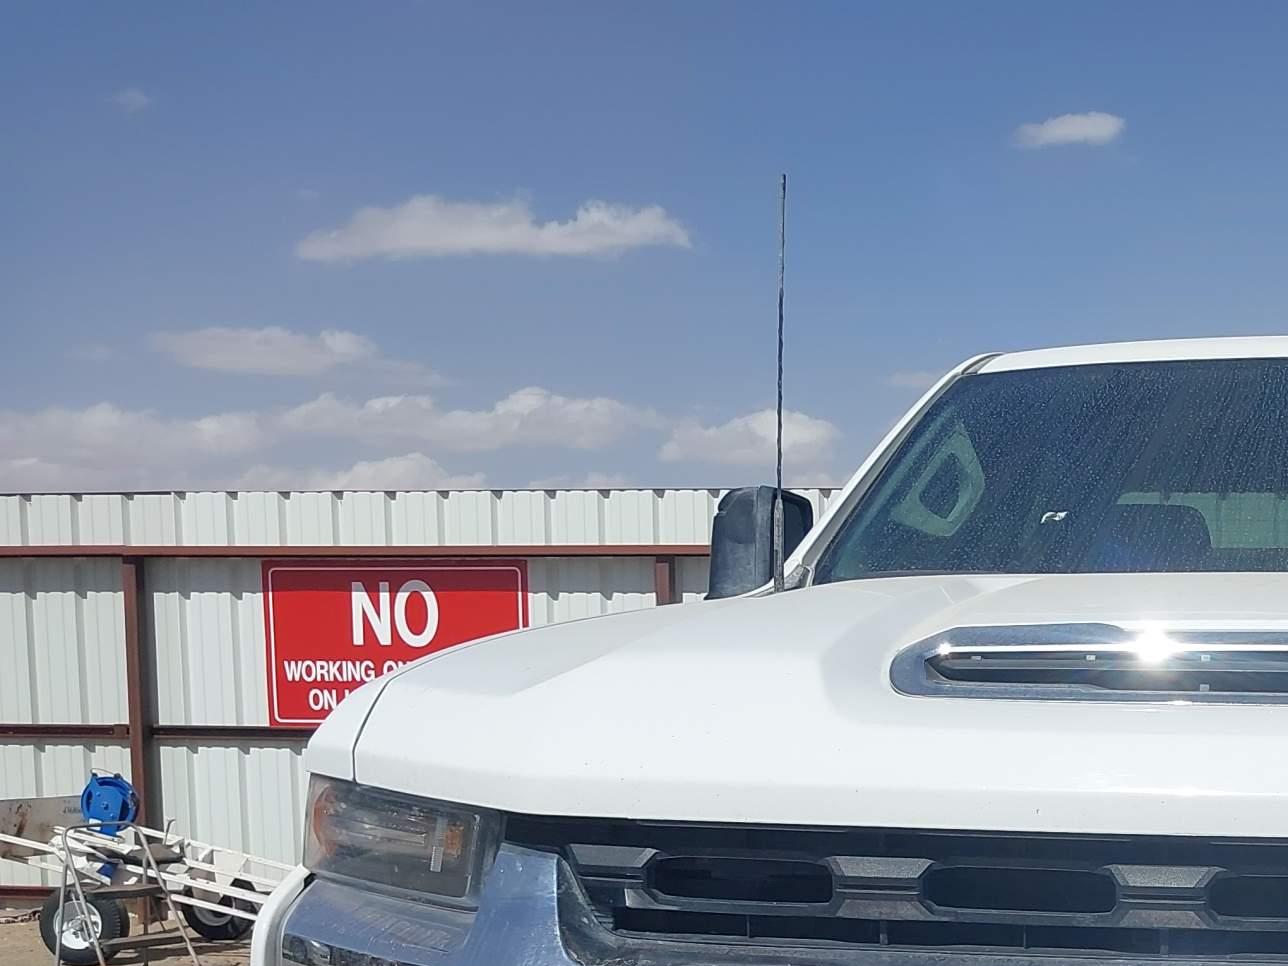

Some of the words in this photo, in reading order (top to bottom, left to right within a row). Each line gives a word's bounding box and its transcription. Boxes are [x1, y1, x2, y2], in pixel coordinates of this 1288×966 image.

[351, 579, 440, 648] NO
[283, 660, 376, 682] WORKING
[308, 688, 338, 711] ON
